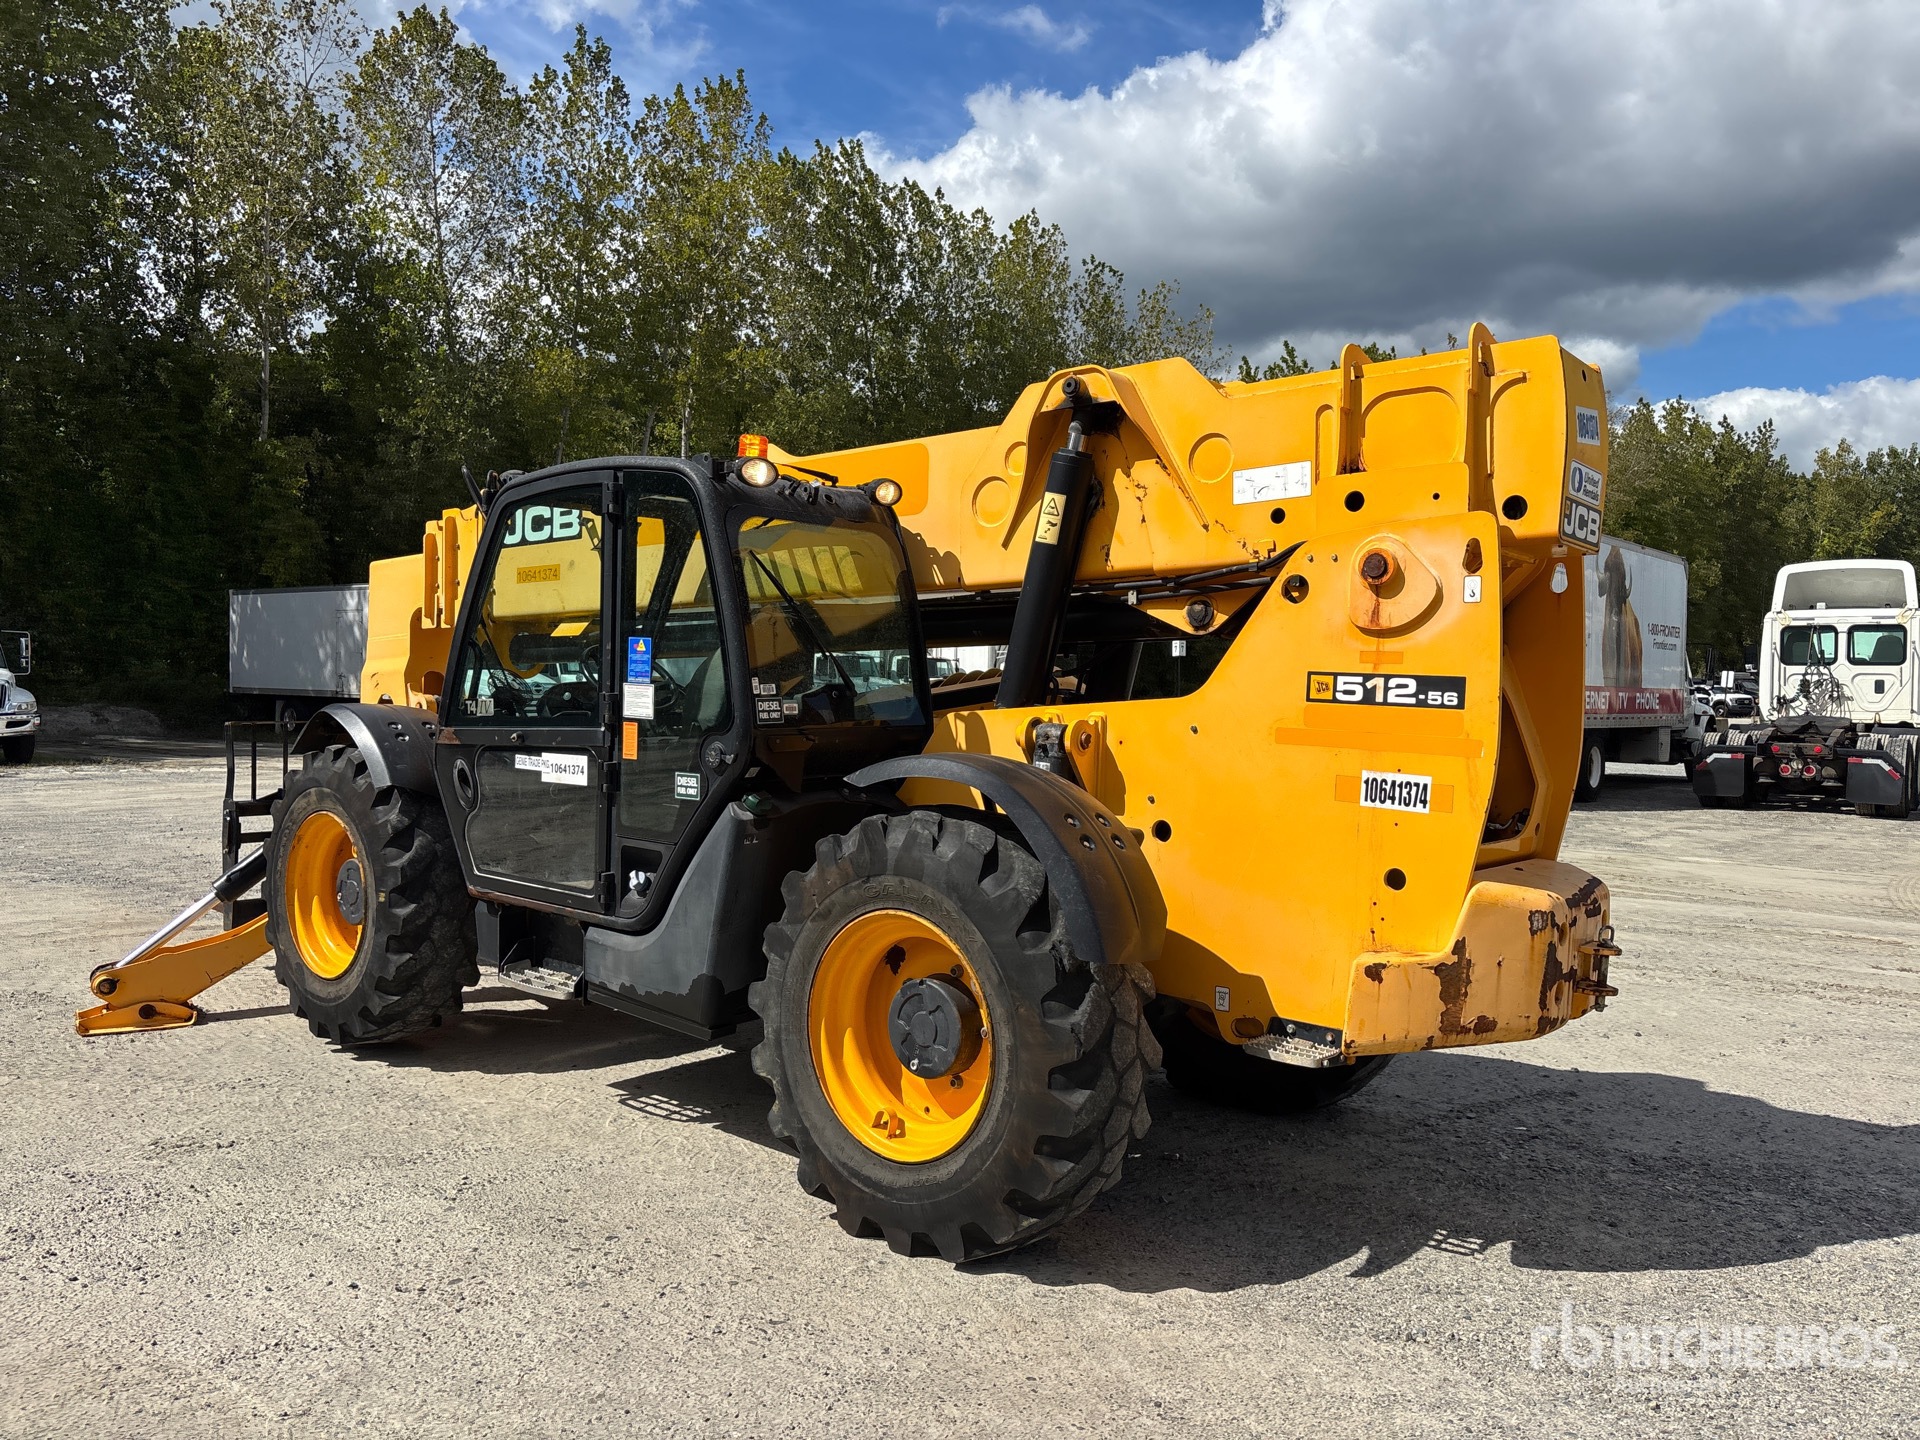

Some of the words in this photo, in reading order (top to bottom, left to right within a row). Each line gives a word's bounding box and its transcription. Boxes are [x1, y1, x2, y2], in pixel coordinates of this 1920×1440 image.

[1584, 471, 1600, 489] United
[1582, 486, 1600, 502] Rentals
[503, 505, 580, 545] JCB
[1563, 502, 1600, 544] JCB
[517, 568, 558, 582] 10641374
[1647, 622, 1681, 639] 1-800-FRONTIER
[1652, 639, 1677, 651] Frontier.com
[1314, 679, 1331, 694] JCB
[1335, 675, 1459, 706] 512-56
[465, 700, 477, 715] T4
[758, 701, 781, 711] DIESEL
[1618, 692, 1629, 710] TV
[1635, 692, 1660, 710] PHONE
[759, 711, 770, 719] FUEL
[770, 711, 781, 719] ONLY
[550, 763, 585, 776] 10641374
[677, 776, 698, 787] DIESEL
[677, 786, 687, 794] FUEL
[686, 787, 698, 795] ONLY
[1363, 776, 1429, 809] 10641374
